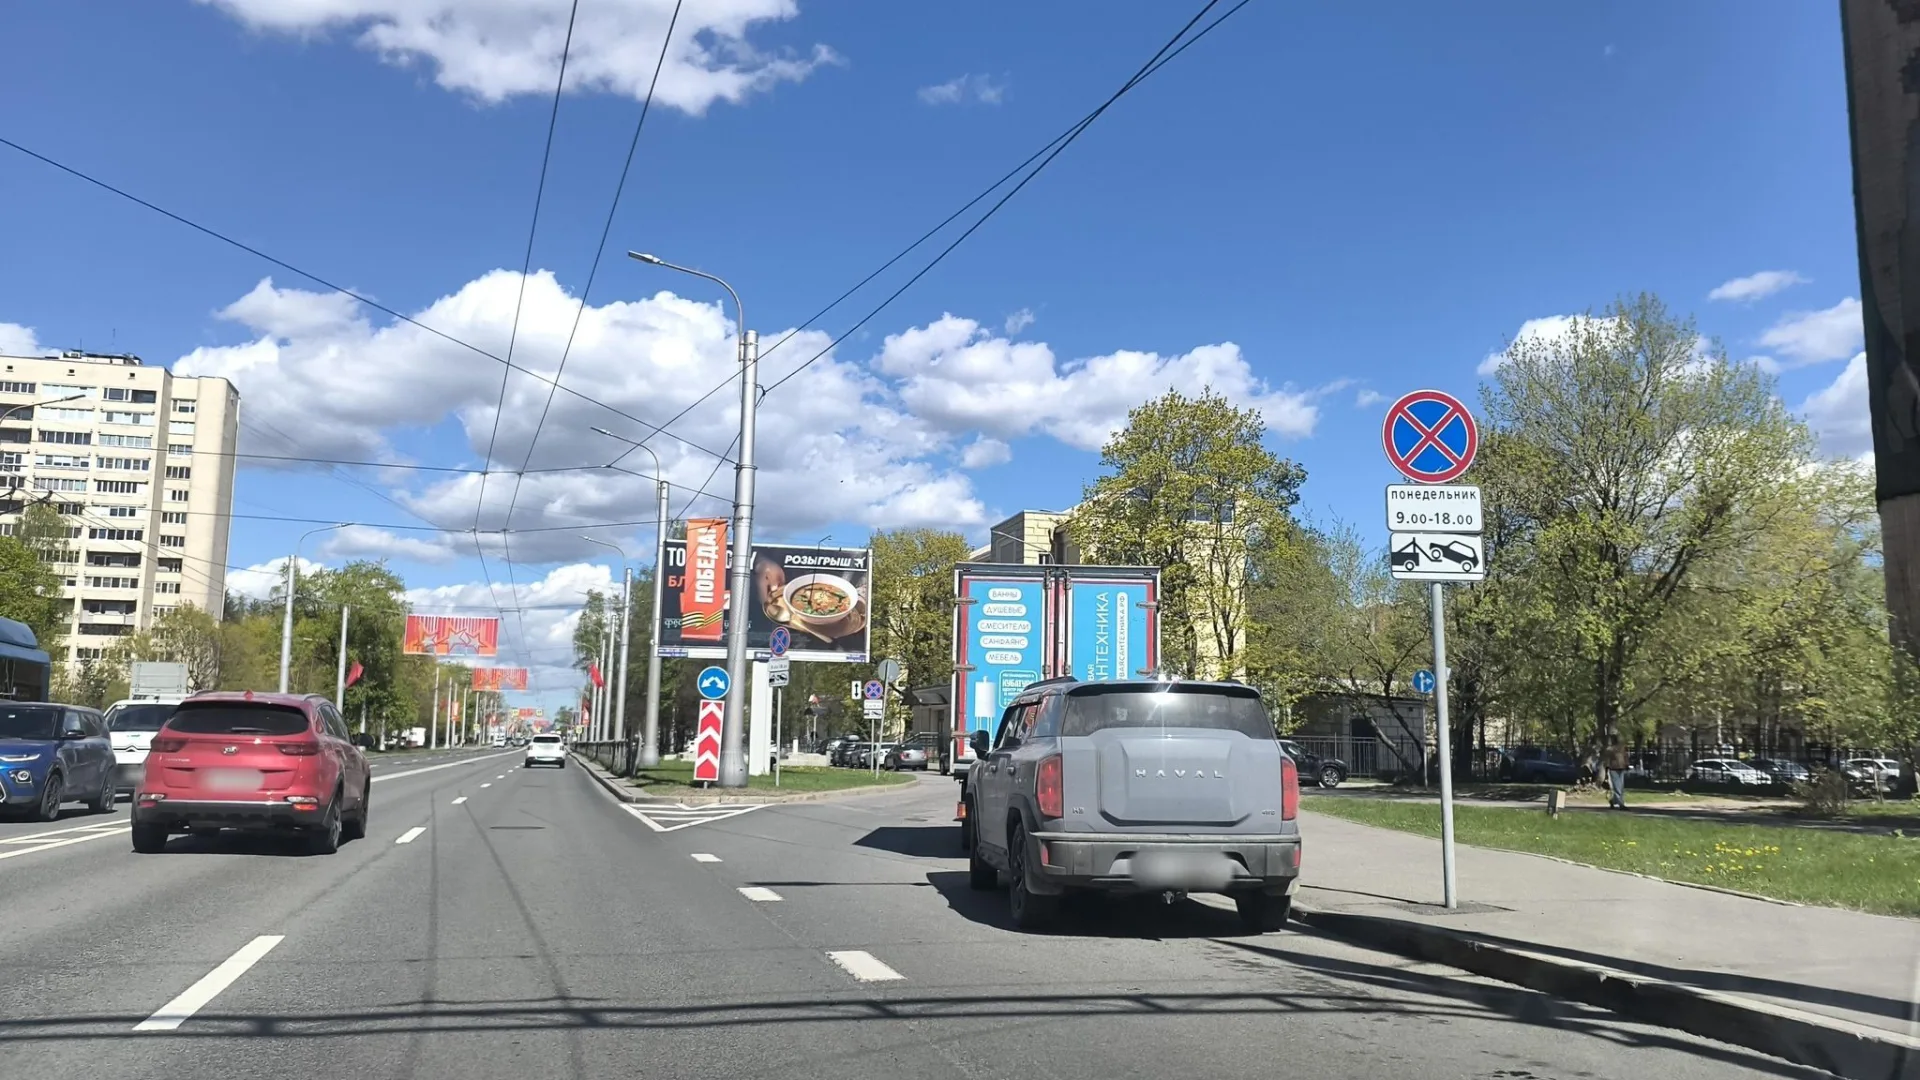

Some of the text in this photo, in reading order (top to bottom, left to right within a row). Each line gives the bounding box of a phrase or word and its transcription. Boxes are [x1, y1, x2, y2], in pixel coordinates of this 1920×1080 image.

[1391, 490, 1476, 500] понедельник
[1396, 511, 1473, 525] 9.00-18.00
[694, 527, 719, 604] ПОБЕДА!
[784, 555, 851, 567] РОЗЫГРЫШ
[992, 590, 1017, 598] ВАННЫ
[986, 606, 1023, 614] ДУШЕВЫЕ
[980, 622, 1029, 631] СМЕСИТЕЛИ
[982, 638, 1025, 646] САНФАЯНС
[1096, 592, 1109, 682] НТЕХНИКА
[1118, 595, 1126, 681] ВАЯСАНТЕХНИКА.РФ
[988, 653, 1019, 662] МЕБЕЛЬ
[1087, 664, 1095, 682] ВАЯ
[1135, 769, 1224, 779] HAVAL
